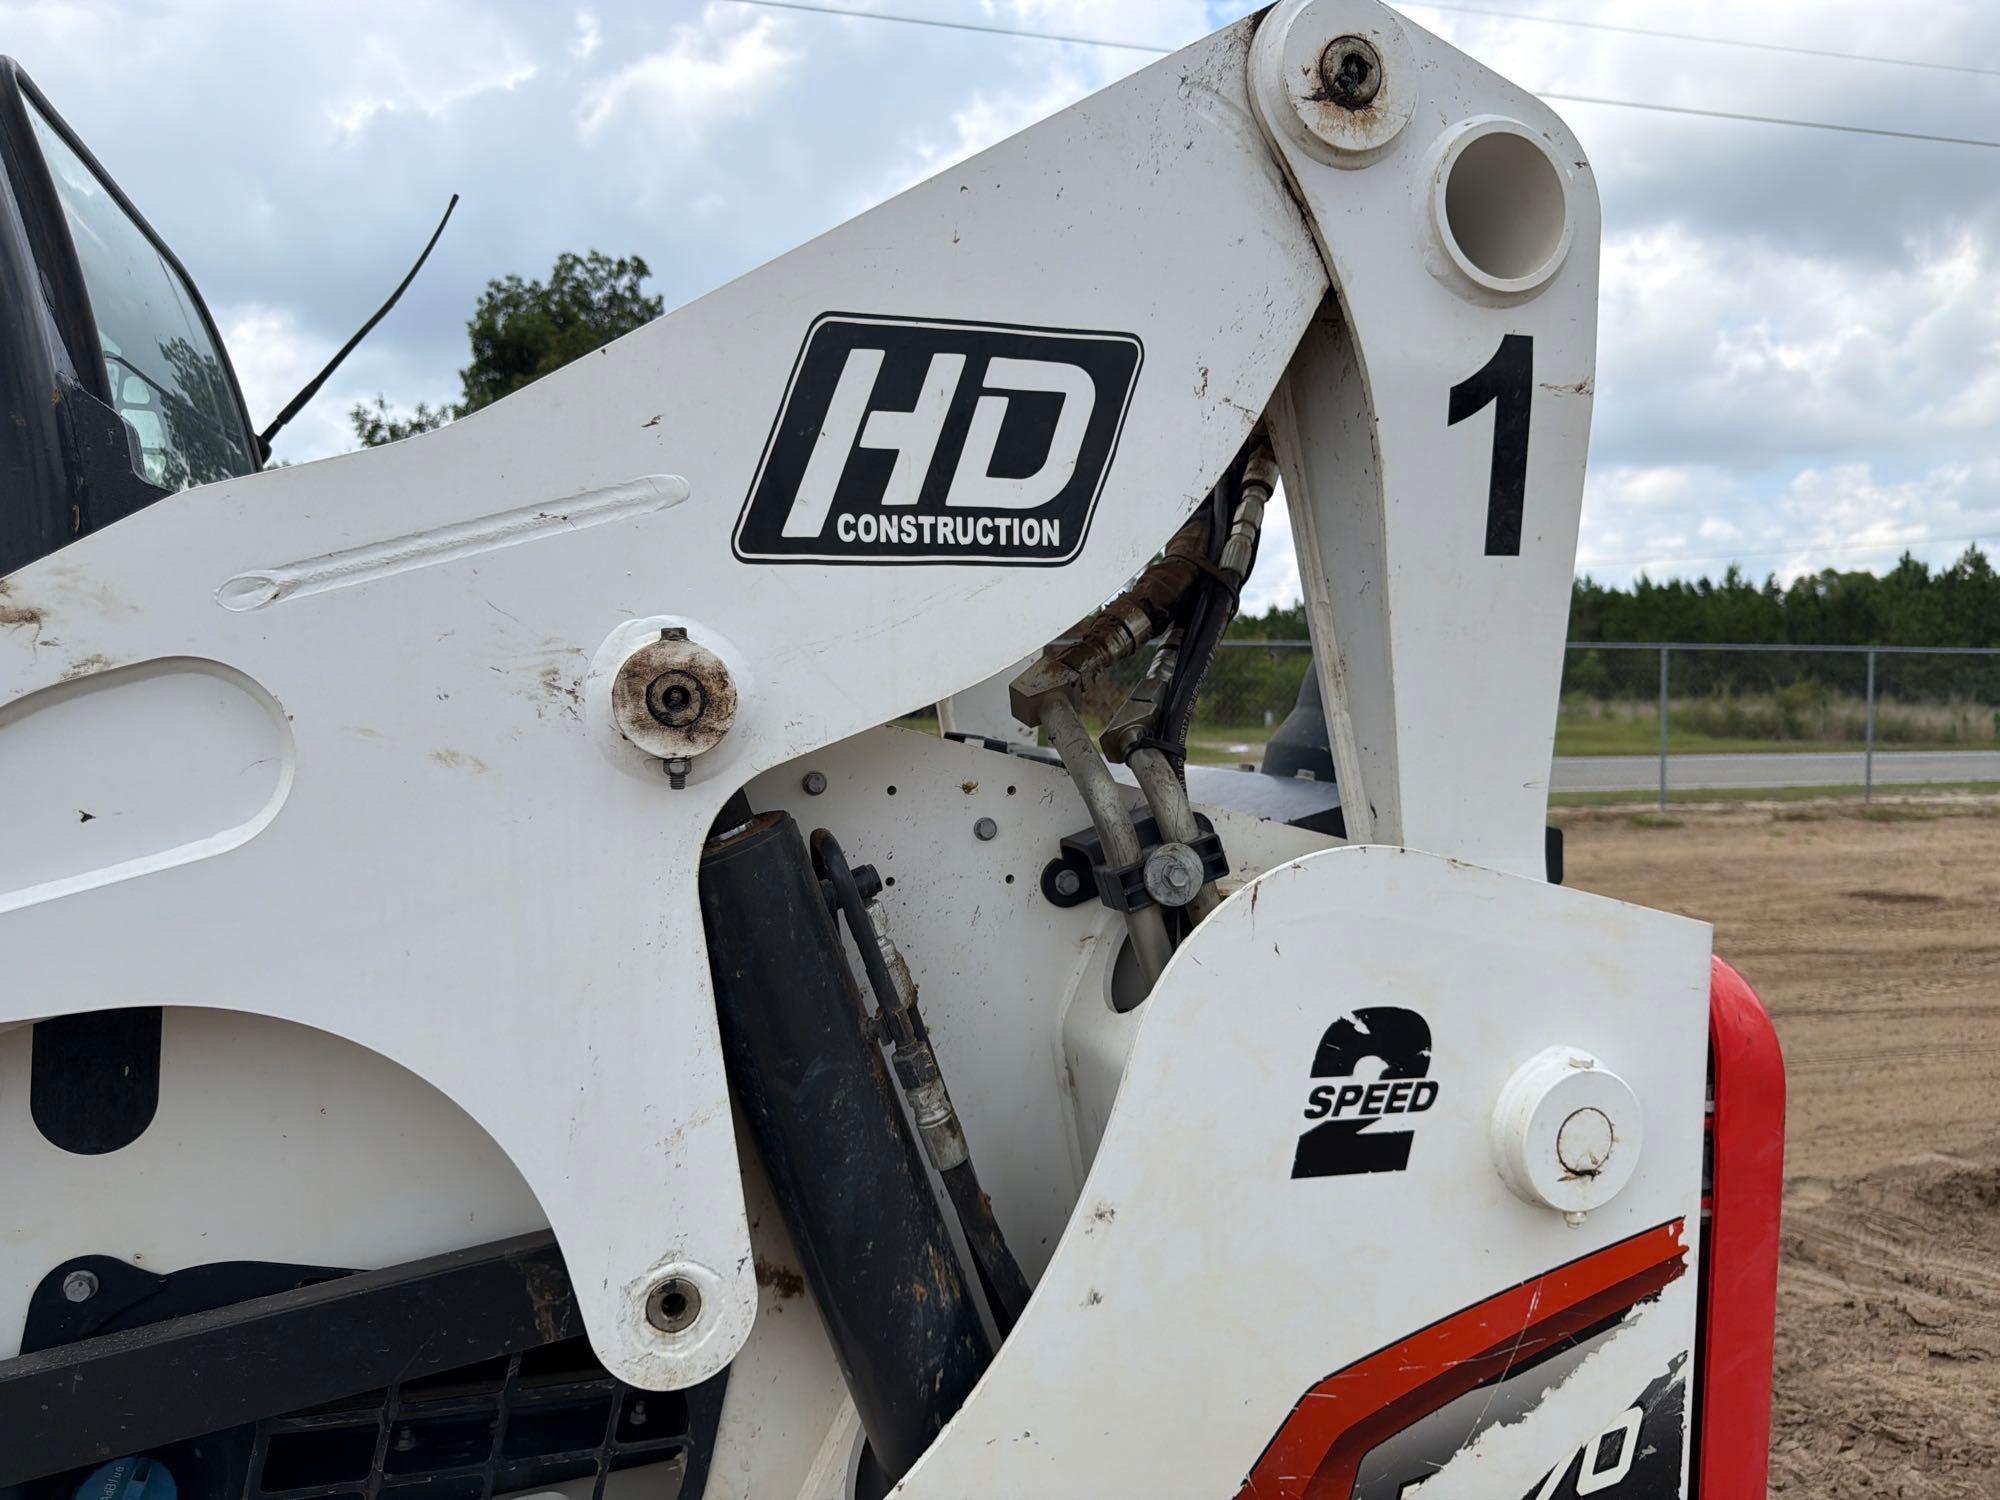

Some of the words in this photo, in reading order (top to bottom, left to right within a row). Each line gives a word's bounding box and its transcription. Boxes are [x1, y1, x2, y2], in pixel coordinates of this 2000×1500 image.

[782, 349, 1095, 537] HD
[1448, 334, 1533, 556] 1
[837, 513, 1059, 546] CONSTRUCTION
[1291, 1007, 1431, 1179] 2
[1304, 1081, 1438, 1119] SPEED
